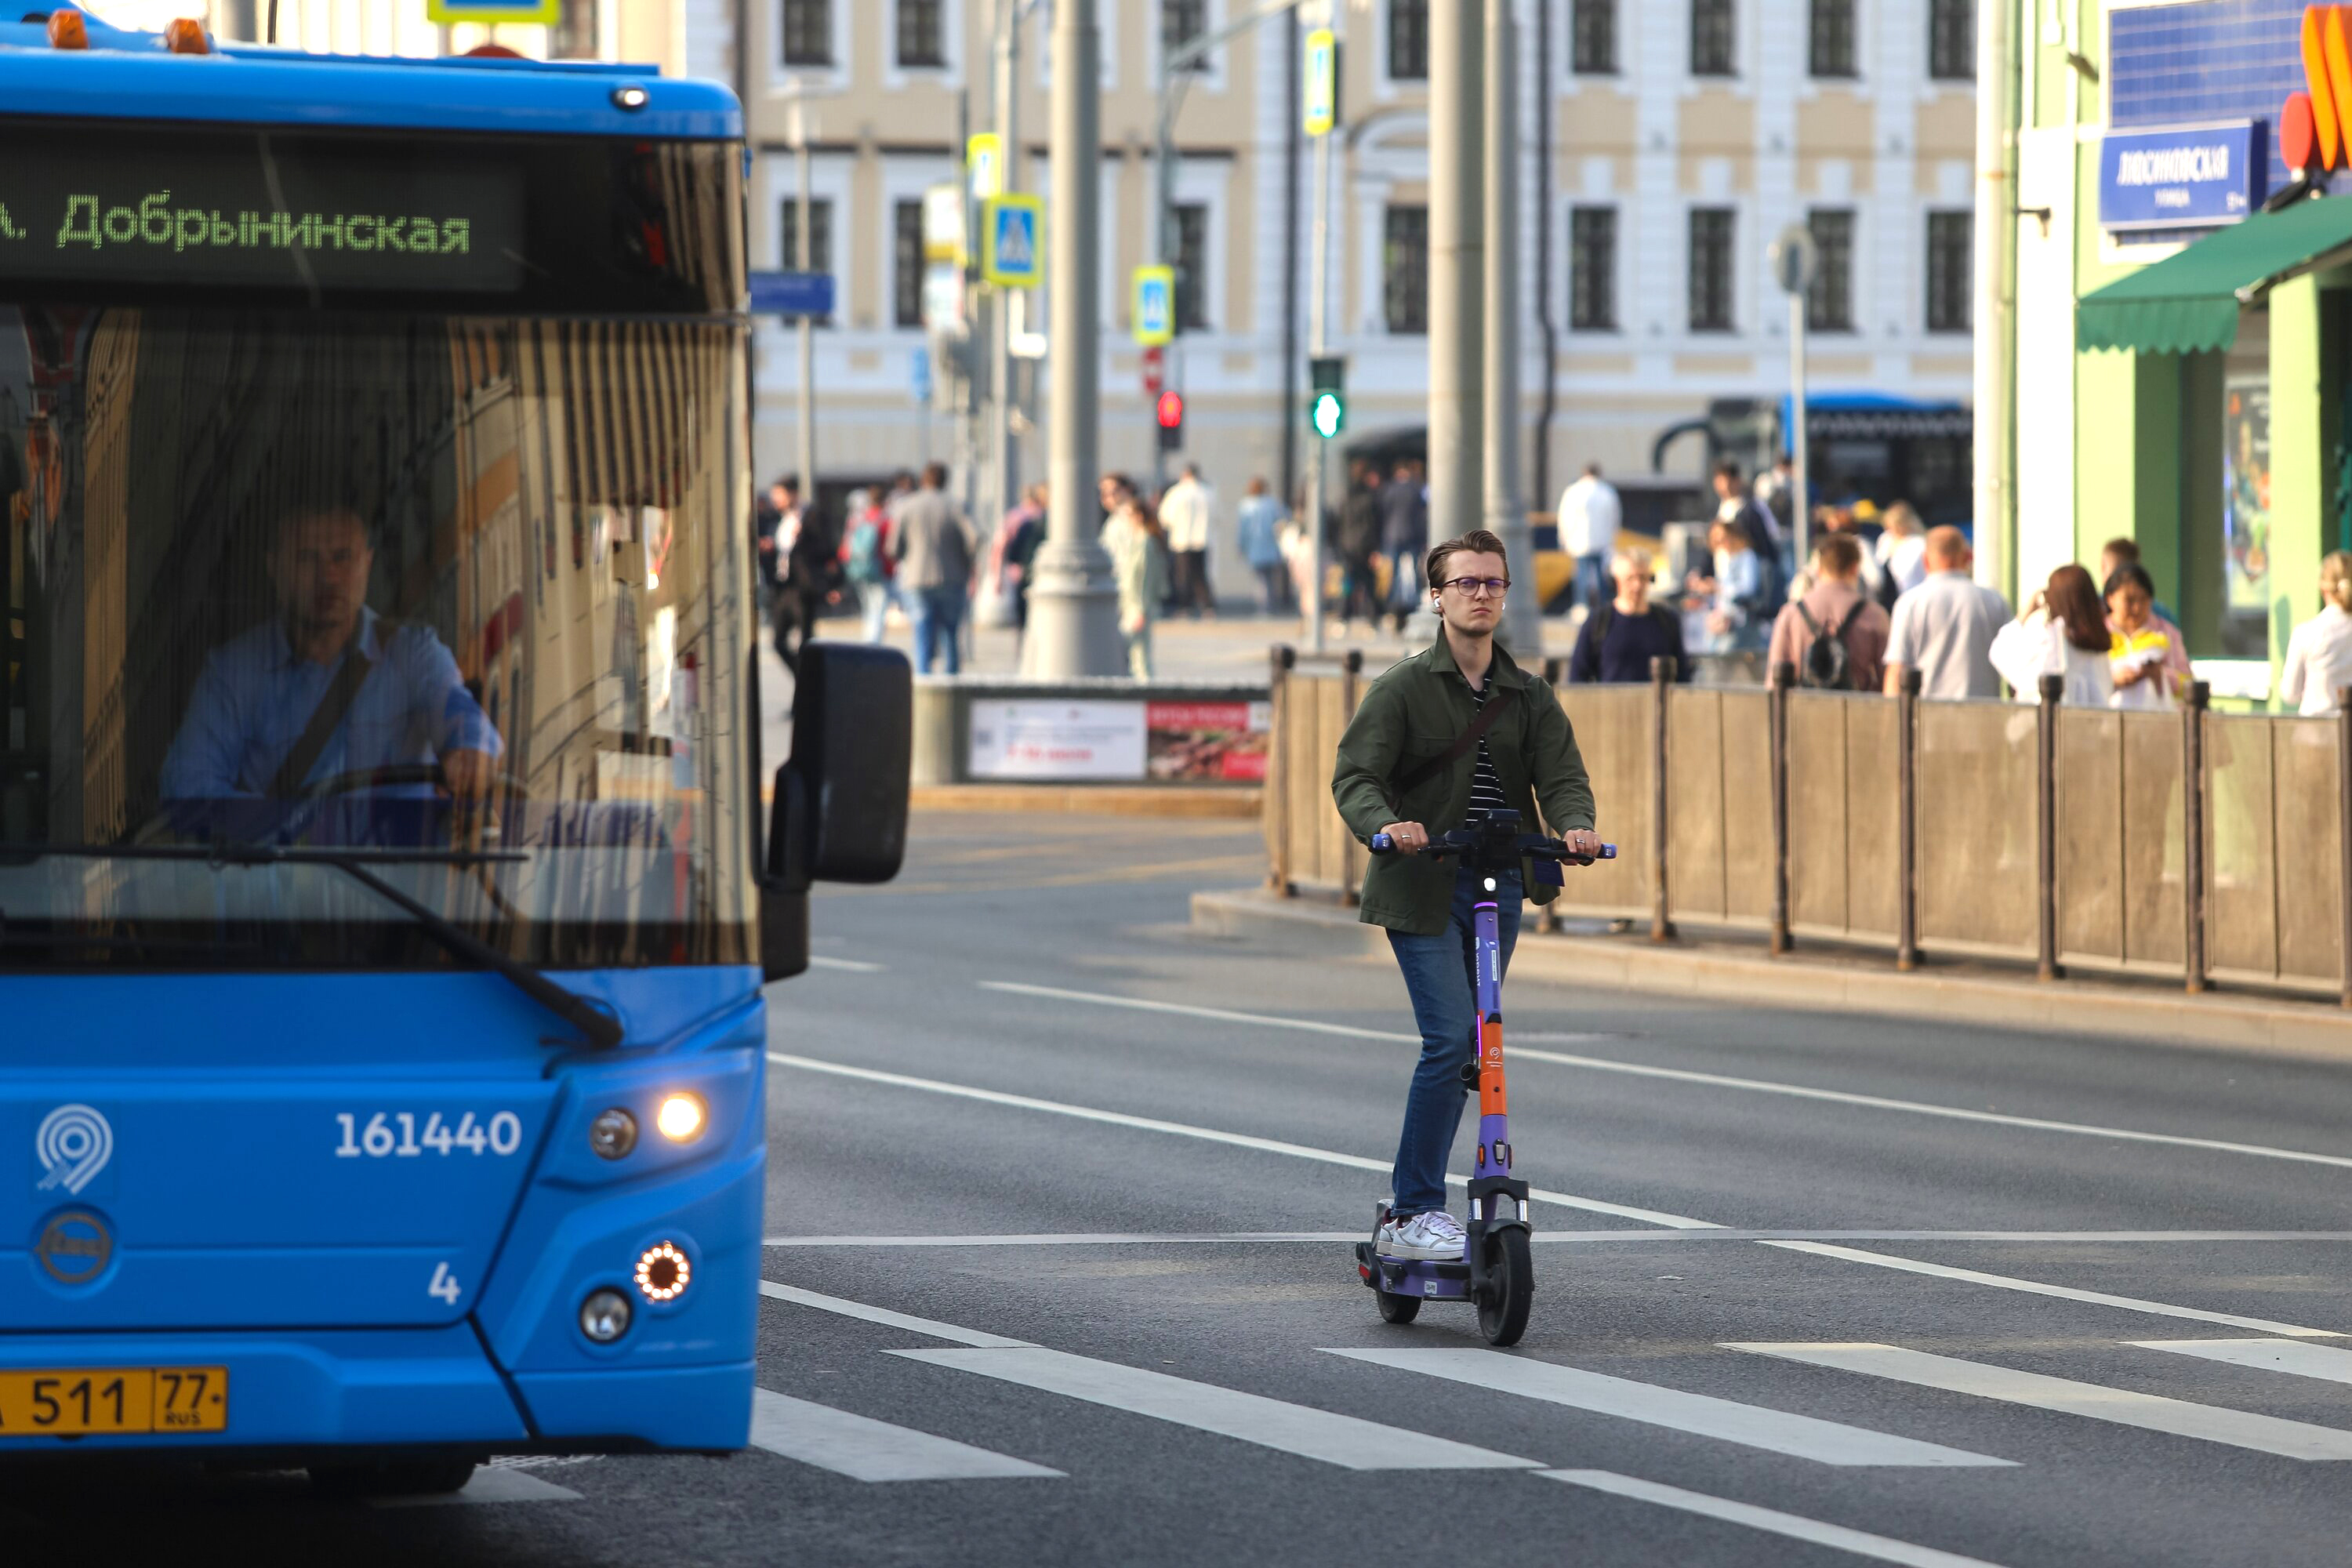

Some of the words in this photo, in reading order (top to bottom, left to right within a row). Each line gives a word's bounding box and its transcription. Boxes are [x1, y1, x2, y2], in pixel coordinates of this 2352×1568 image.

[56, 189, 470, 253] Добрынинская
[335, 1110, 523, 1158] 161440
[427, 1261, 462, 1305] 4
[32, 1377, 125, 1425] 511
[161, 1374, 209, 1409] 77
[165, 1411, 201, 1425] RUS
